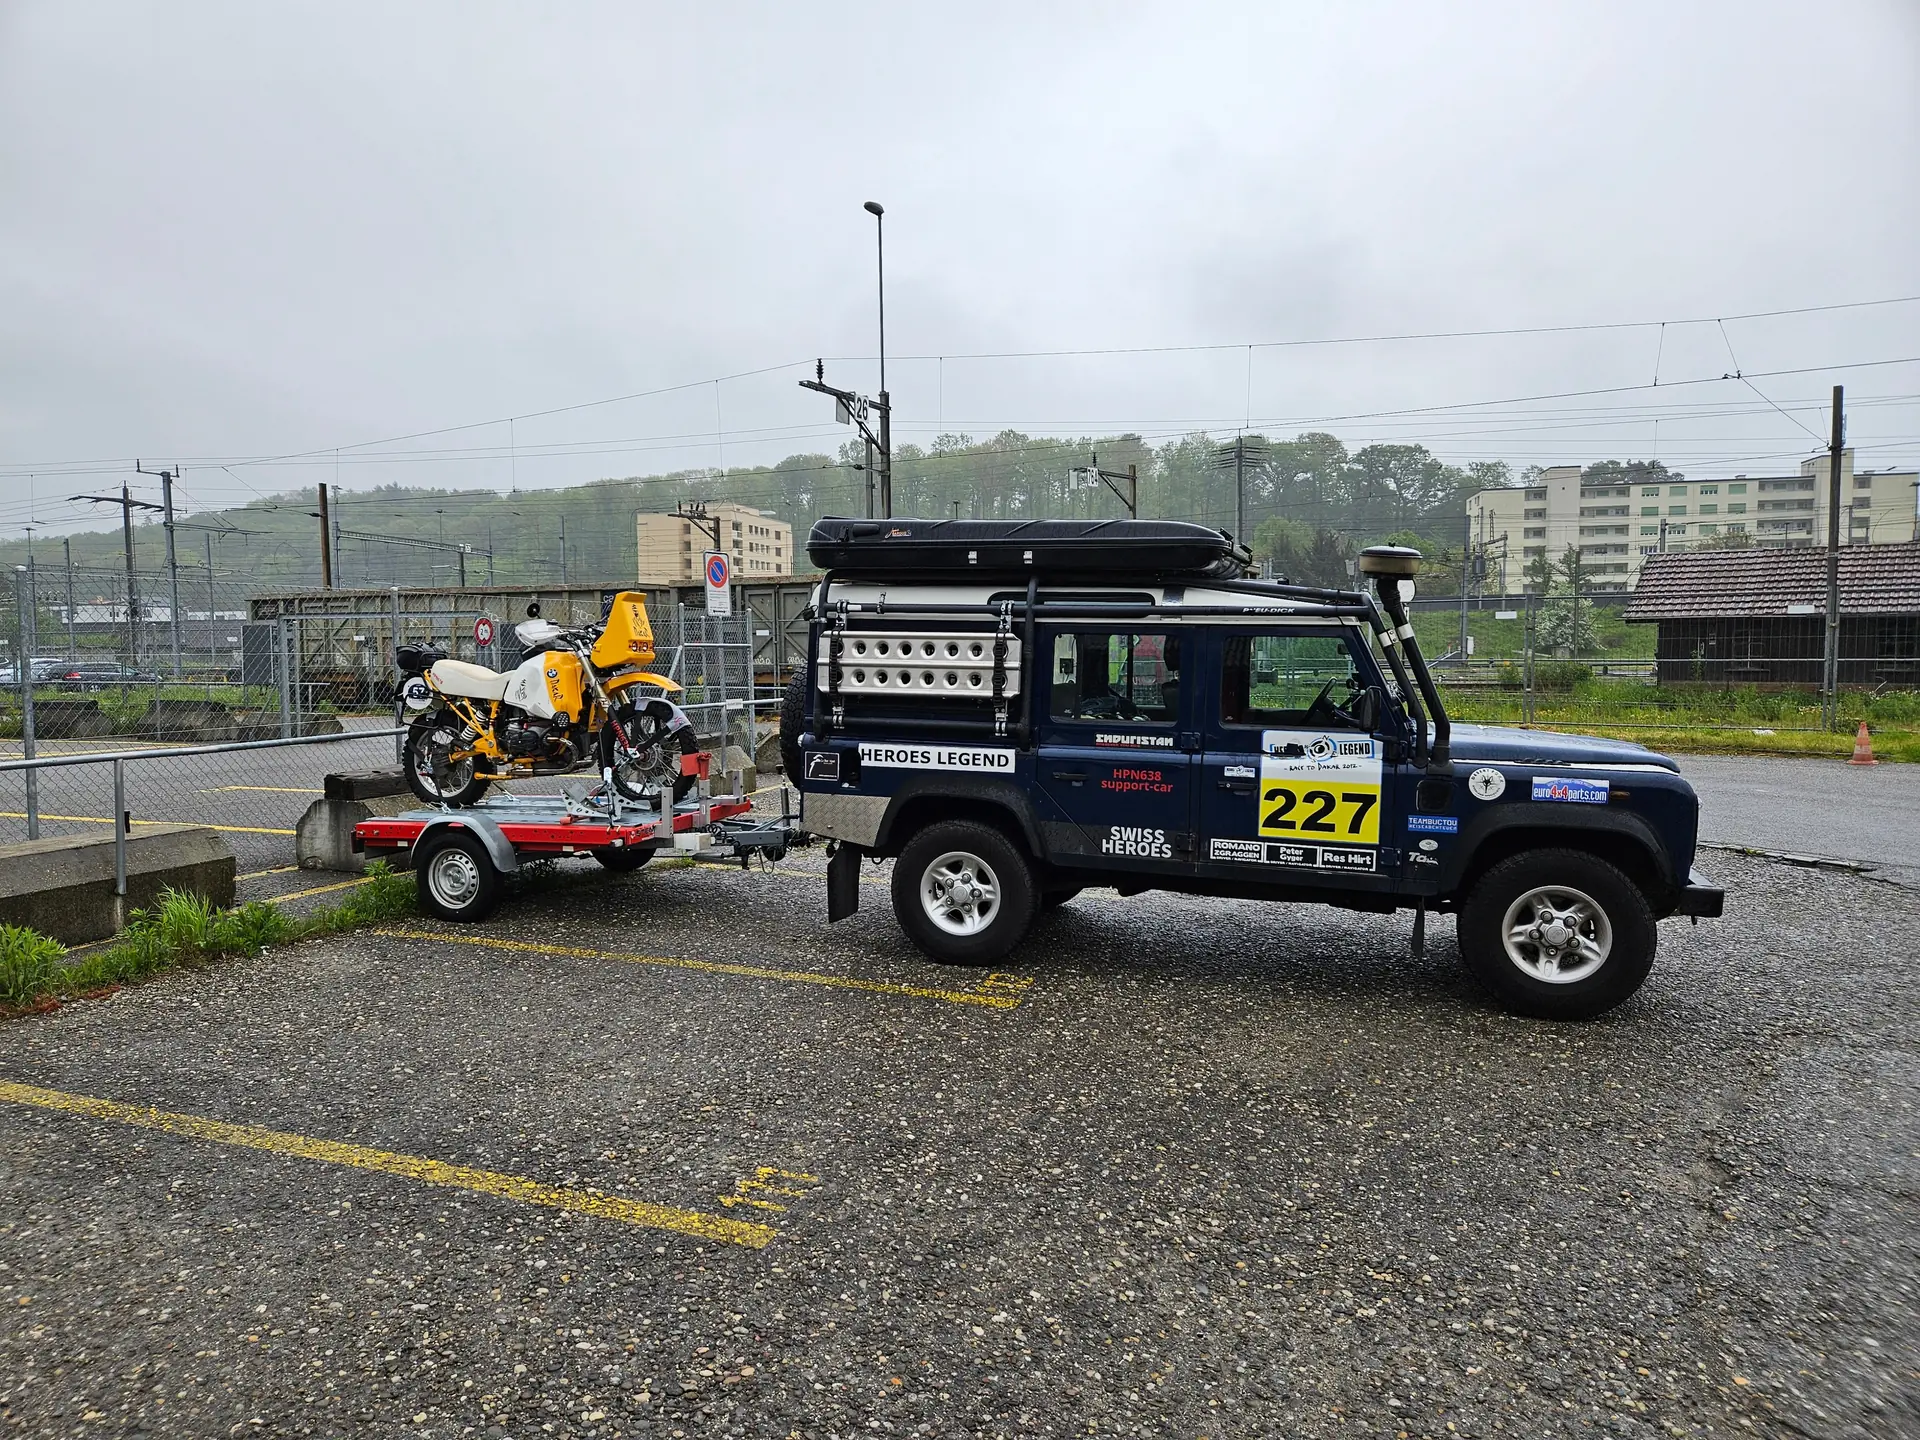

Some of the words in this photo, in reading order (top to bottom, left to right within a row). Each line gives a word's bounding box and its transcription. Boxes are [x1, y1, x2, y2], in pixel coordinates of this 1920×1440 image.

[856, 396, 868, 421] 26
[1339, 742, 1371, 755] LEGEND
[860, 748, 931, 764] HEROES
[937, 751, 1010, 768] LEGEND
[1113, 769, 1162, 781] HPN638
[1101, 780, 1174, 792] support-car
[1533, 784, 1607, 802] euro4x4parts.com
[1262, 788, 1378, 834] 227
[1408, 817, 1458, 826] TEAMBUCTOU
[1110, 826, 1165, 844] SWISS
[1101, 839, 1172, 858] HEROES
[1214, 841, 1260, 851] ROMANO
[1279, 846, 1304, 855] Peter
[1213, 849, 1260, 859] ZGRAGGEN
[1279, 853, 1304, 862] Gyger
[1323, 852, 1346, 863] Res
[1347, 854, 1372, 865] Hirt
